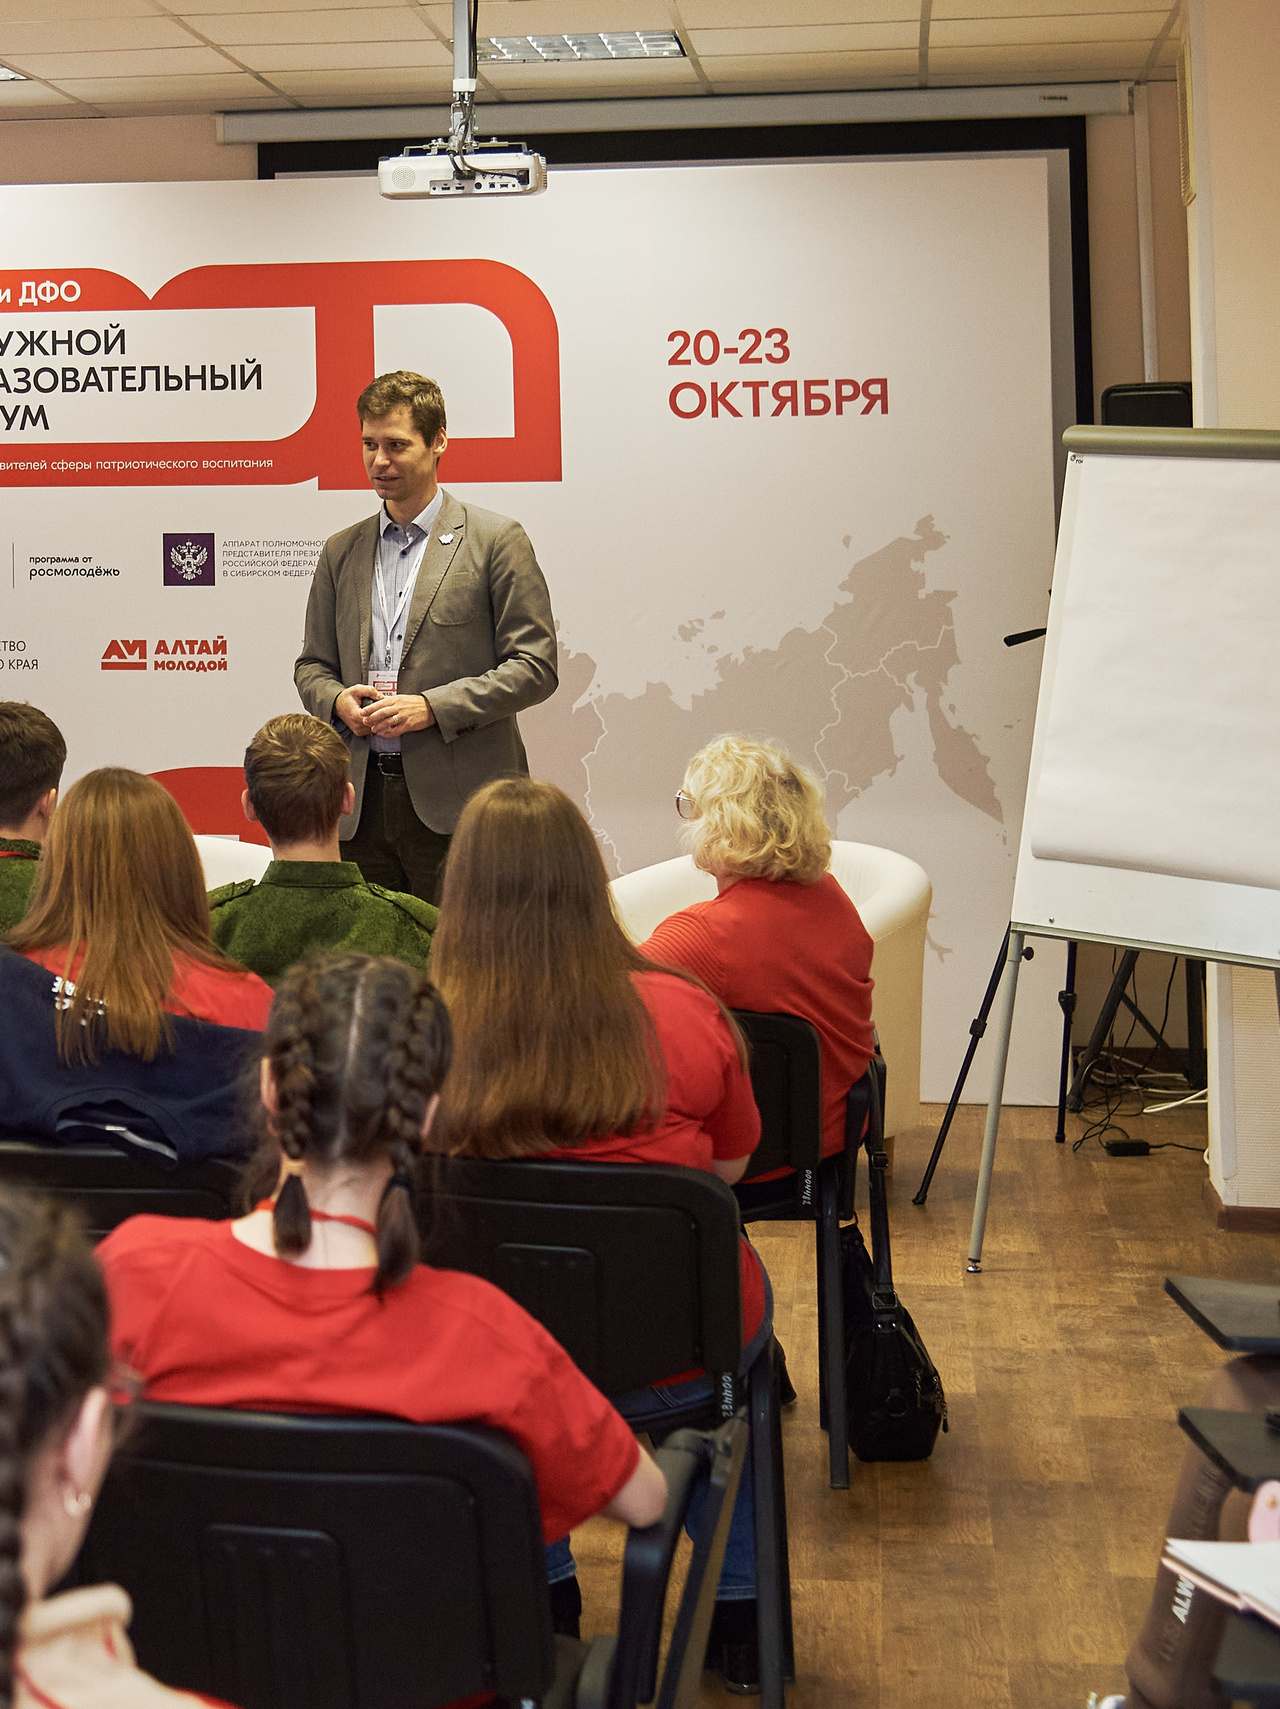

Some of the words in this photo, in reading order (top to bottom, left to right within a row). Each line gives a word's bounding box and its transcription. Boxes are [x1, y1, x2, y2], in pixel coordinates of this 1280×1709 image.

[19, 281, 80, 306] ДФО
[668, 328, 790, 365] 20-23
[669, 378, 888, 419] ОКТЯБРЯ
[50, 459, 92, 473] сферы
[95, 460, 199, 472] патриотического
[202, 459, 273, 469] воспитания
[29, 556, 80, 565] программа
[81, 556, 93, 564] от
[222, 550, 291, 558] ПРЕДСТАВИТЕЛЯ
[222, 559, 279, 567] РОССИЙСКОЙ
[281, 559, 318, 568] ФЕДЕРА
[29, 565, 120, 581] росмолодёжь
[222, 569, 229, 577] В
[230, 569, 281, 577] СИБИРСКОМ
[282, 569, 316, 577] ФЕДЕРА
[154, 635, 228, 656] АЛТАЙ
[8, 658, 39, 670] КРАЯ
[153, 657, 228, 673] МОЛОДОЙ
[1171, 1576, 1195, 1625] ALW
